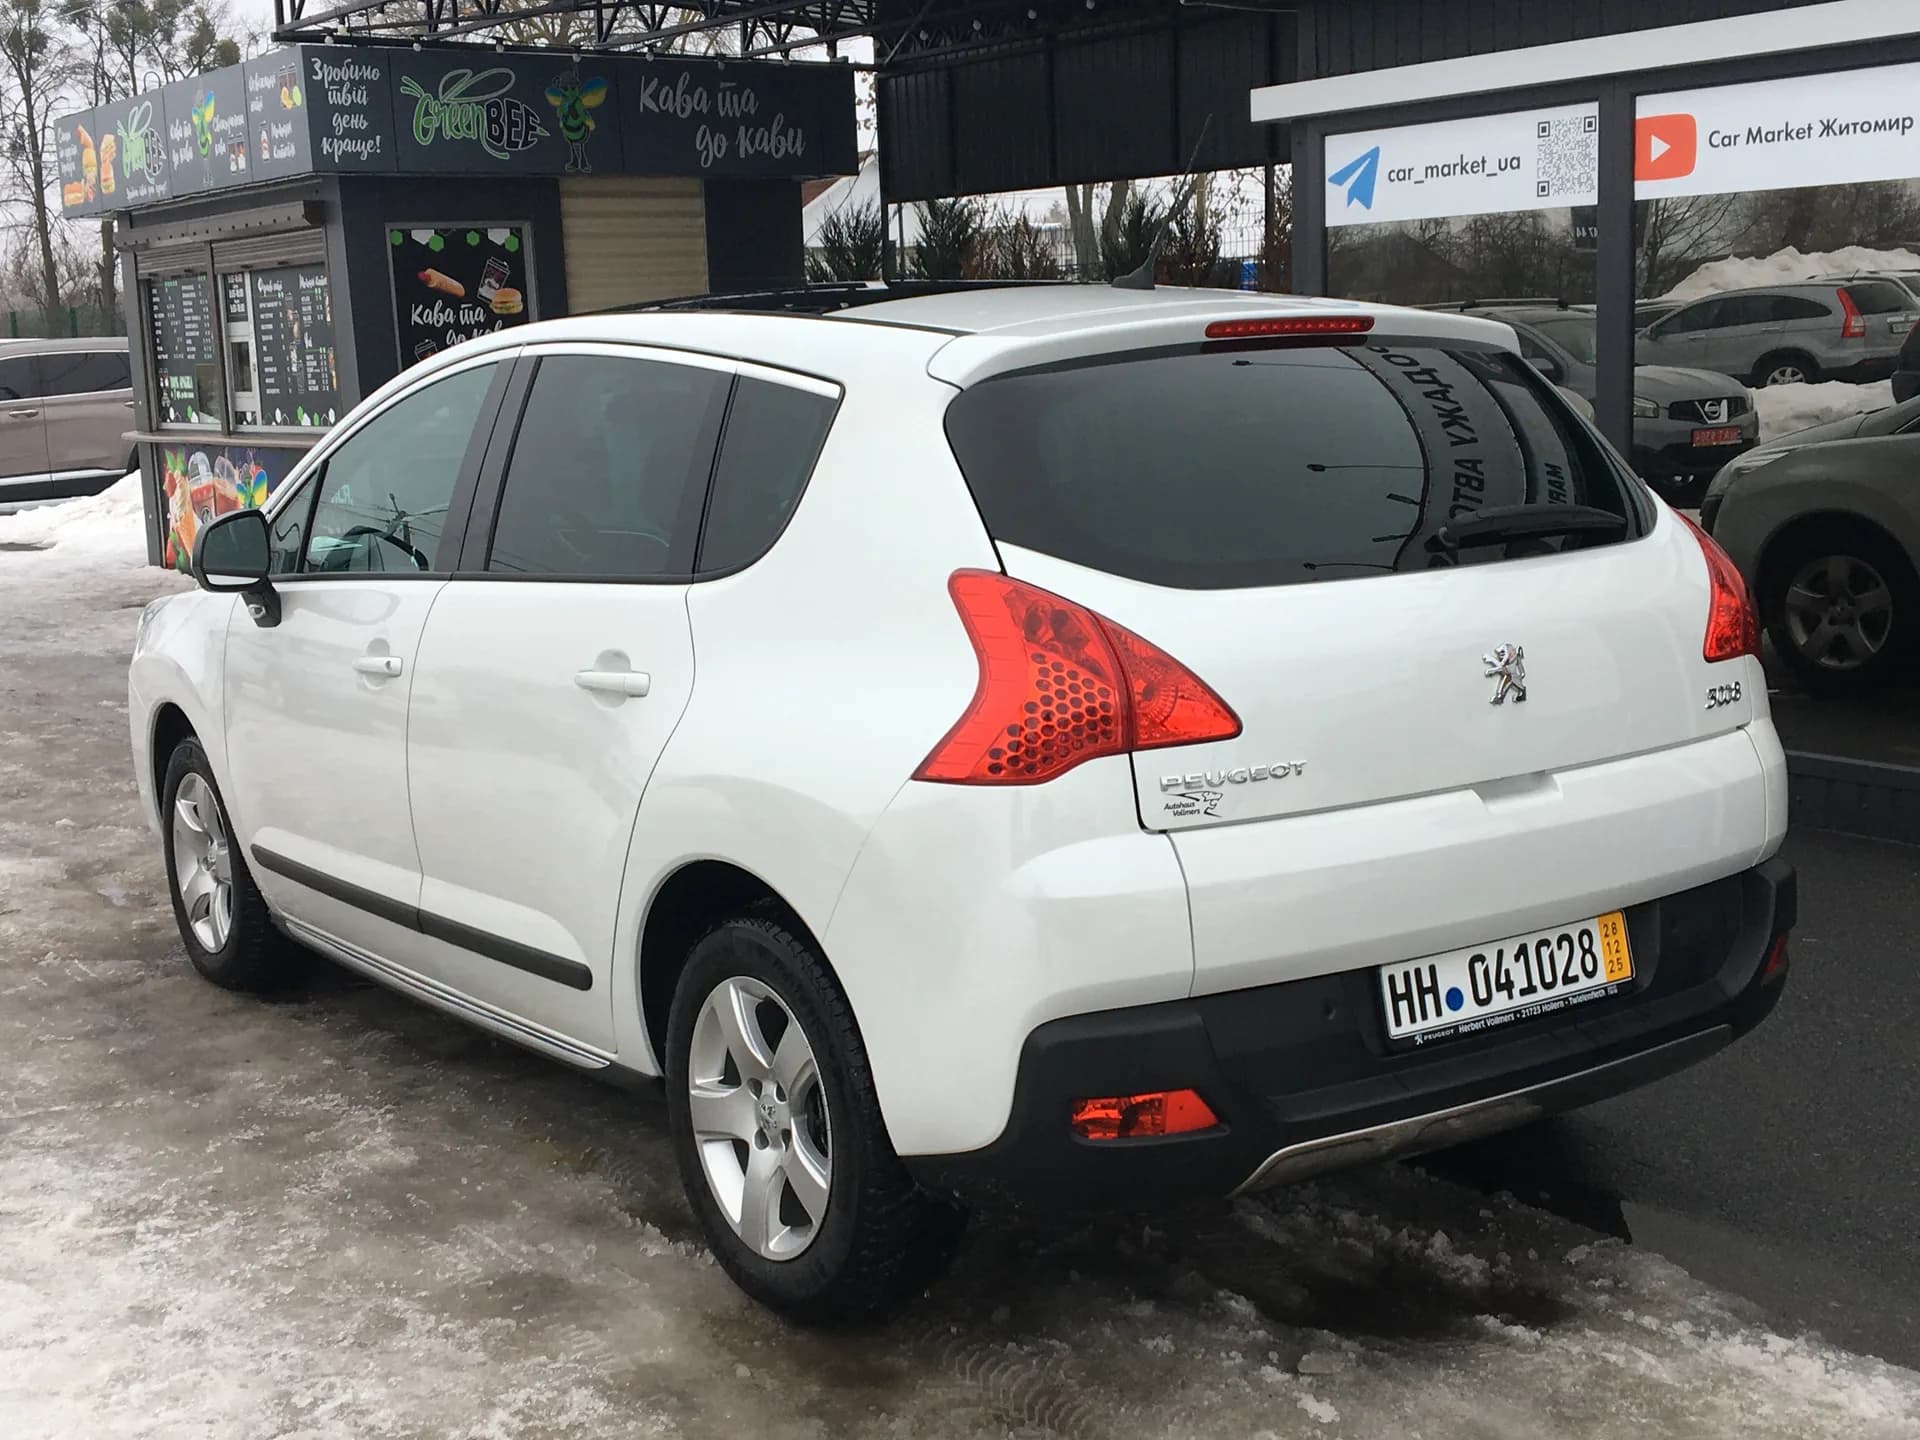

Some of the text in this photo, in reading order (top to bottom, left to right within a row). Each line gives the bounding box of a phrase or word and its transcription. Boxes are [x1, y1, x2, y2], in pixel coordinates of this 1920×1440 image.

[311, 58, 380, 88] Зробимо
[328, 82, 368, 106] твій
[640, 72, 759, 118] Кава та
[332, 112, 368, 136] день
[1709, 116, 1914, 149] Car Market Житомир
[321, 135, 381, 163] краще!
[696, 113, 806, 168] до кави
[1388, 154, 1521, 184] car_market_ua
[411, 299, 487, 327] Кава та
[1160, 760, 1307, 792] PEUGEOT
[1164, 801, 1196, 810] Autohaus
[1172, 808, 1201, 817] Vollmers
[1603, 922, 1617, 938] 28
[1606, 940, 1621, 955] 12
[1388, 928, 1599, 1028] HH 041028
[1608, 958, 1623, 974] 25
[1459, 1020, 1486, 1033] Herbert
[1521, 1005, 1542, 1018] 21723
